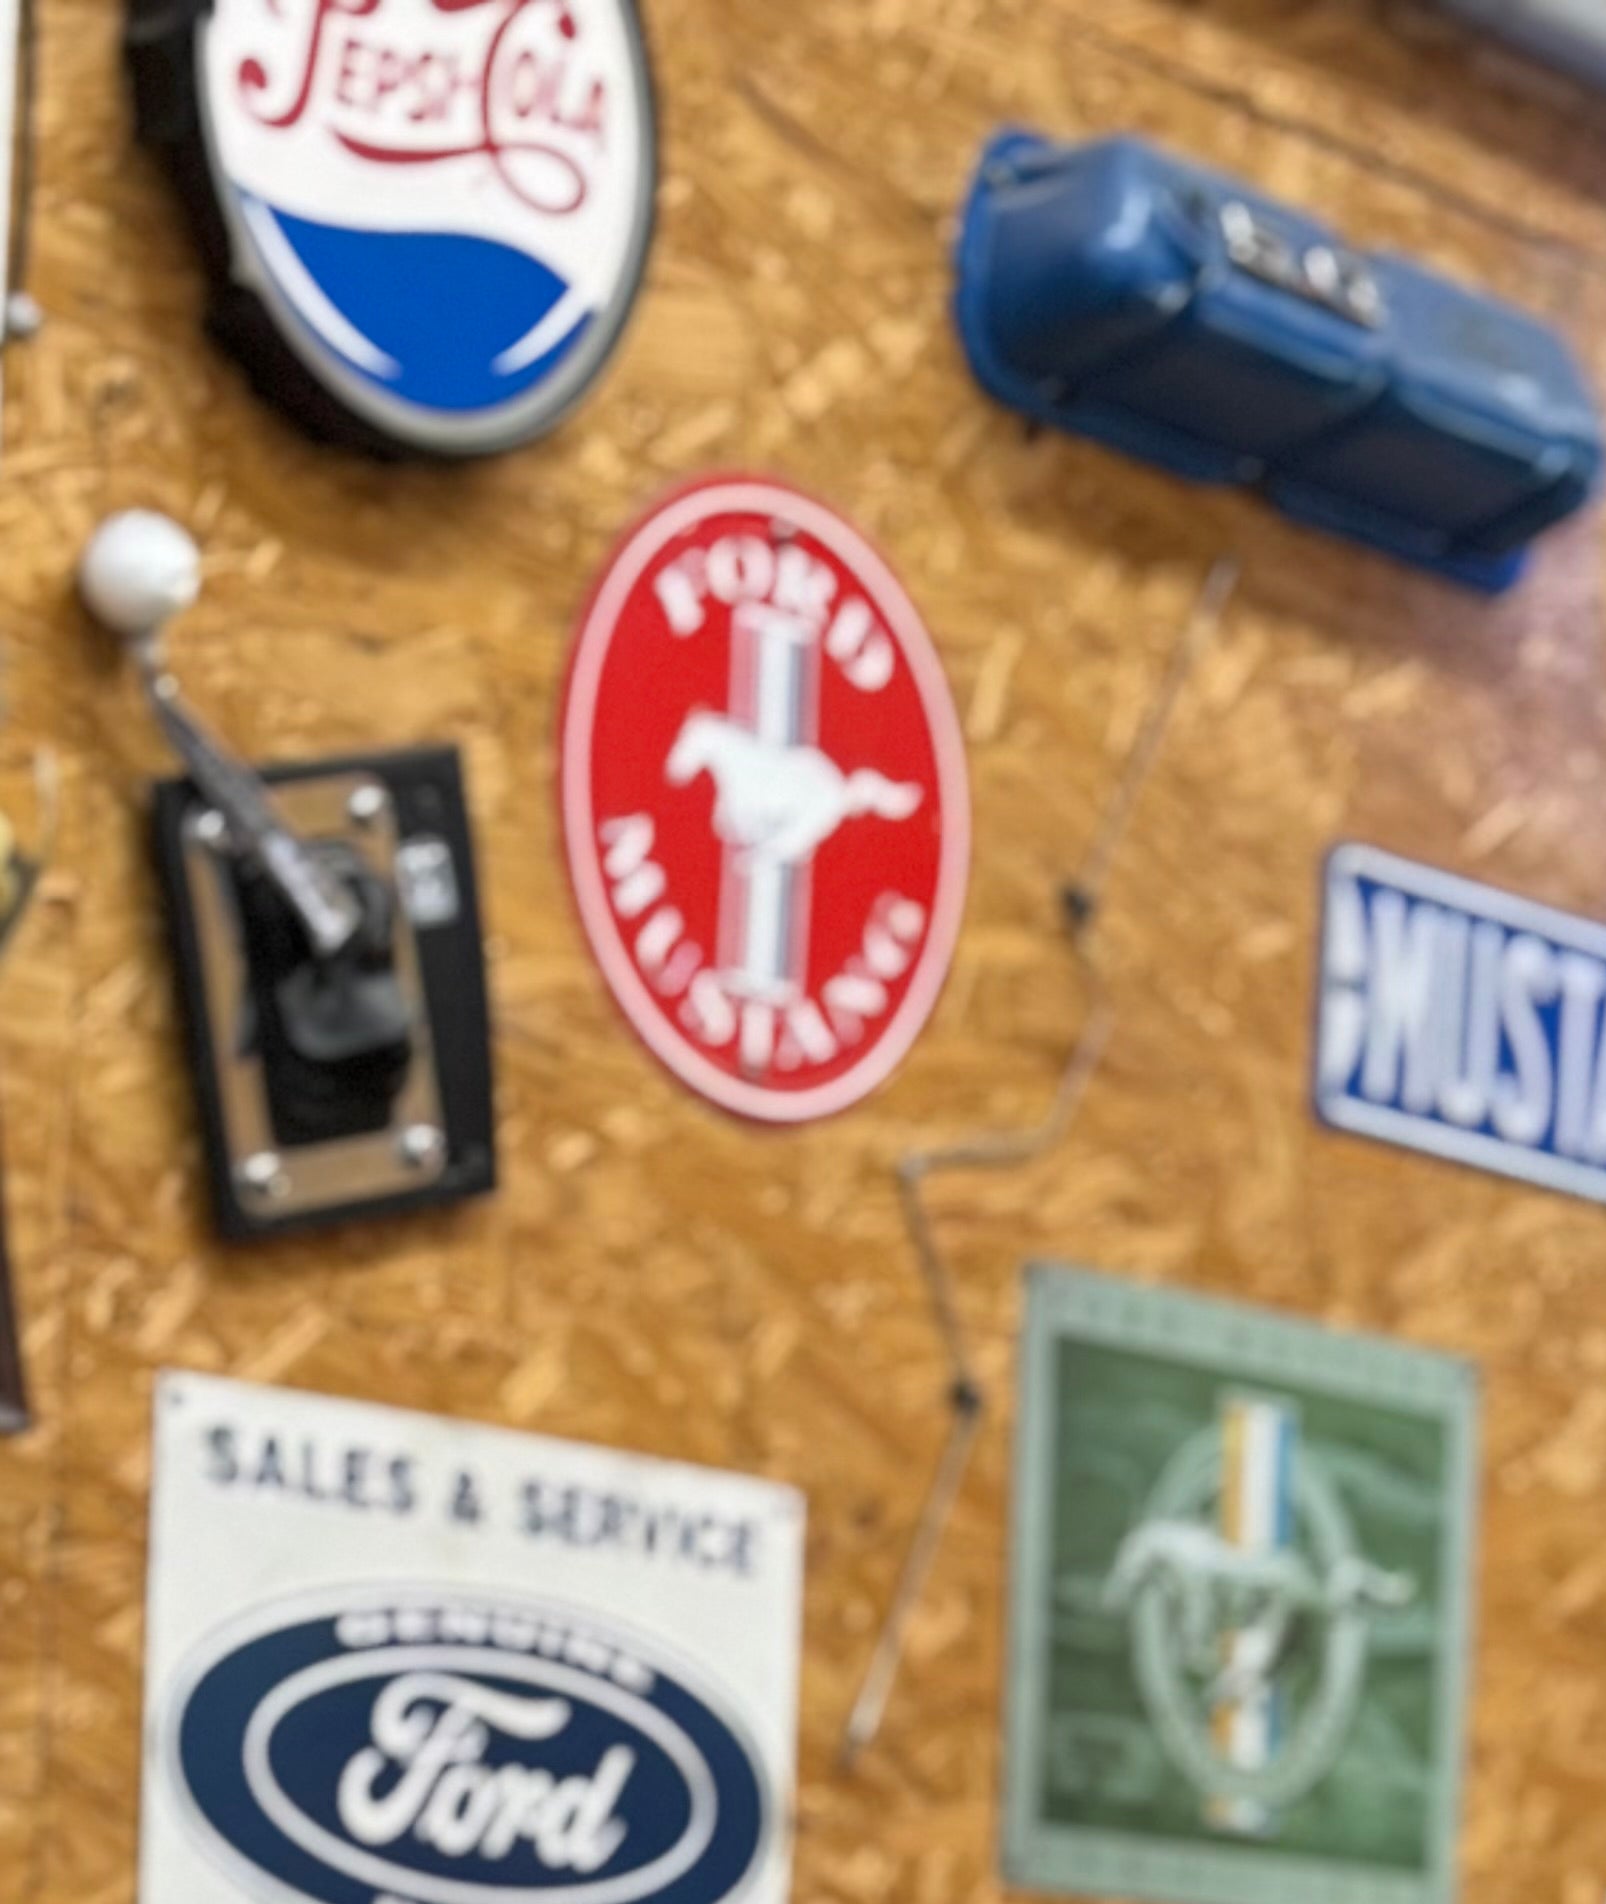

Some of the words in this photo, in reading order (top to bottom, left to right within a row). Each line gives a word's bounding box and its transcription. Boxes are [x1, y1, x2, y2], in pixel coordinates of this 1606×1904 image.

[652, 533, 896, 694] FORD
[600, 810, 927, 1072] MUSTANG
[203, 1424, 416, 1517] SALES
[443, 1472, 486, 1528] &
[518, 1478, 762, 1579] SERVICE
[336, 1669, 637, 1873] Ford
